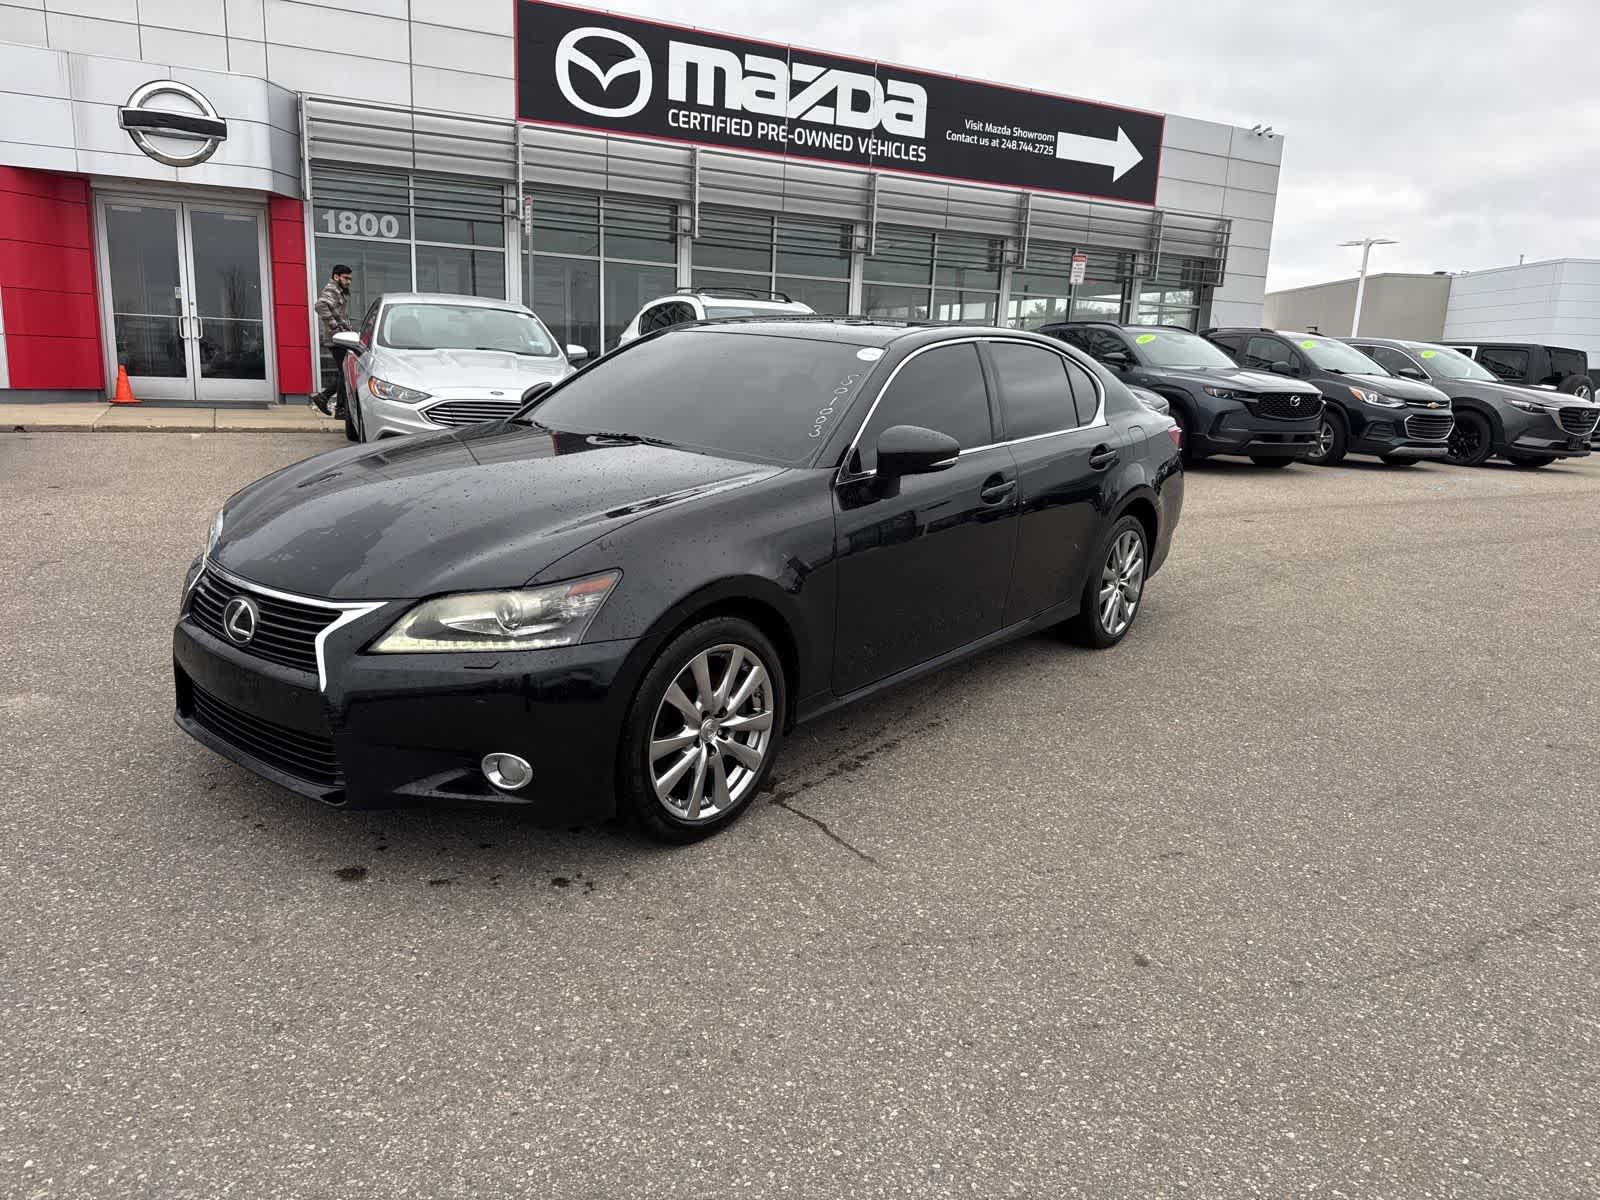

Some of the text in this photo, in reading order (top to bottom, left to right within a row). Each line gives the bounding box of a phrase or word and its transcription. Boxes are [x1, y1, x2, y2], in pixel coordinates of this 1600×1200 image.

[668, 108, 927, 162] CERTIFIED PRE-OWNED VEHICLES
[945, 130, 1054, 156] Contact us at 248.744.2725
[964, 119, 1055, 143] Visit Mazda Showroom
[322, 209, 400, 238] 1800
